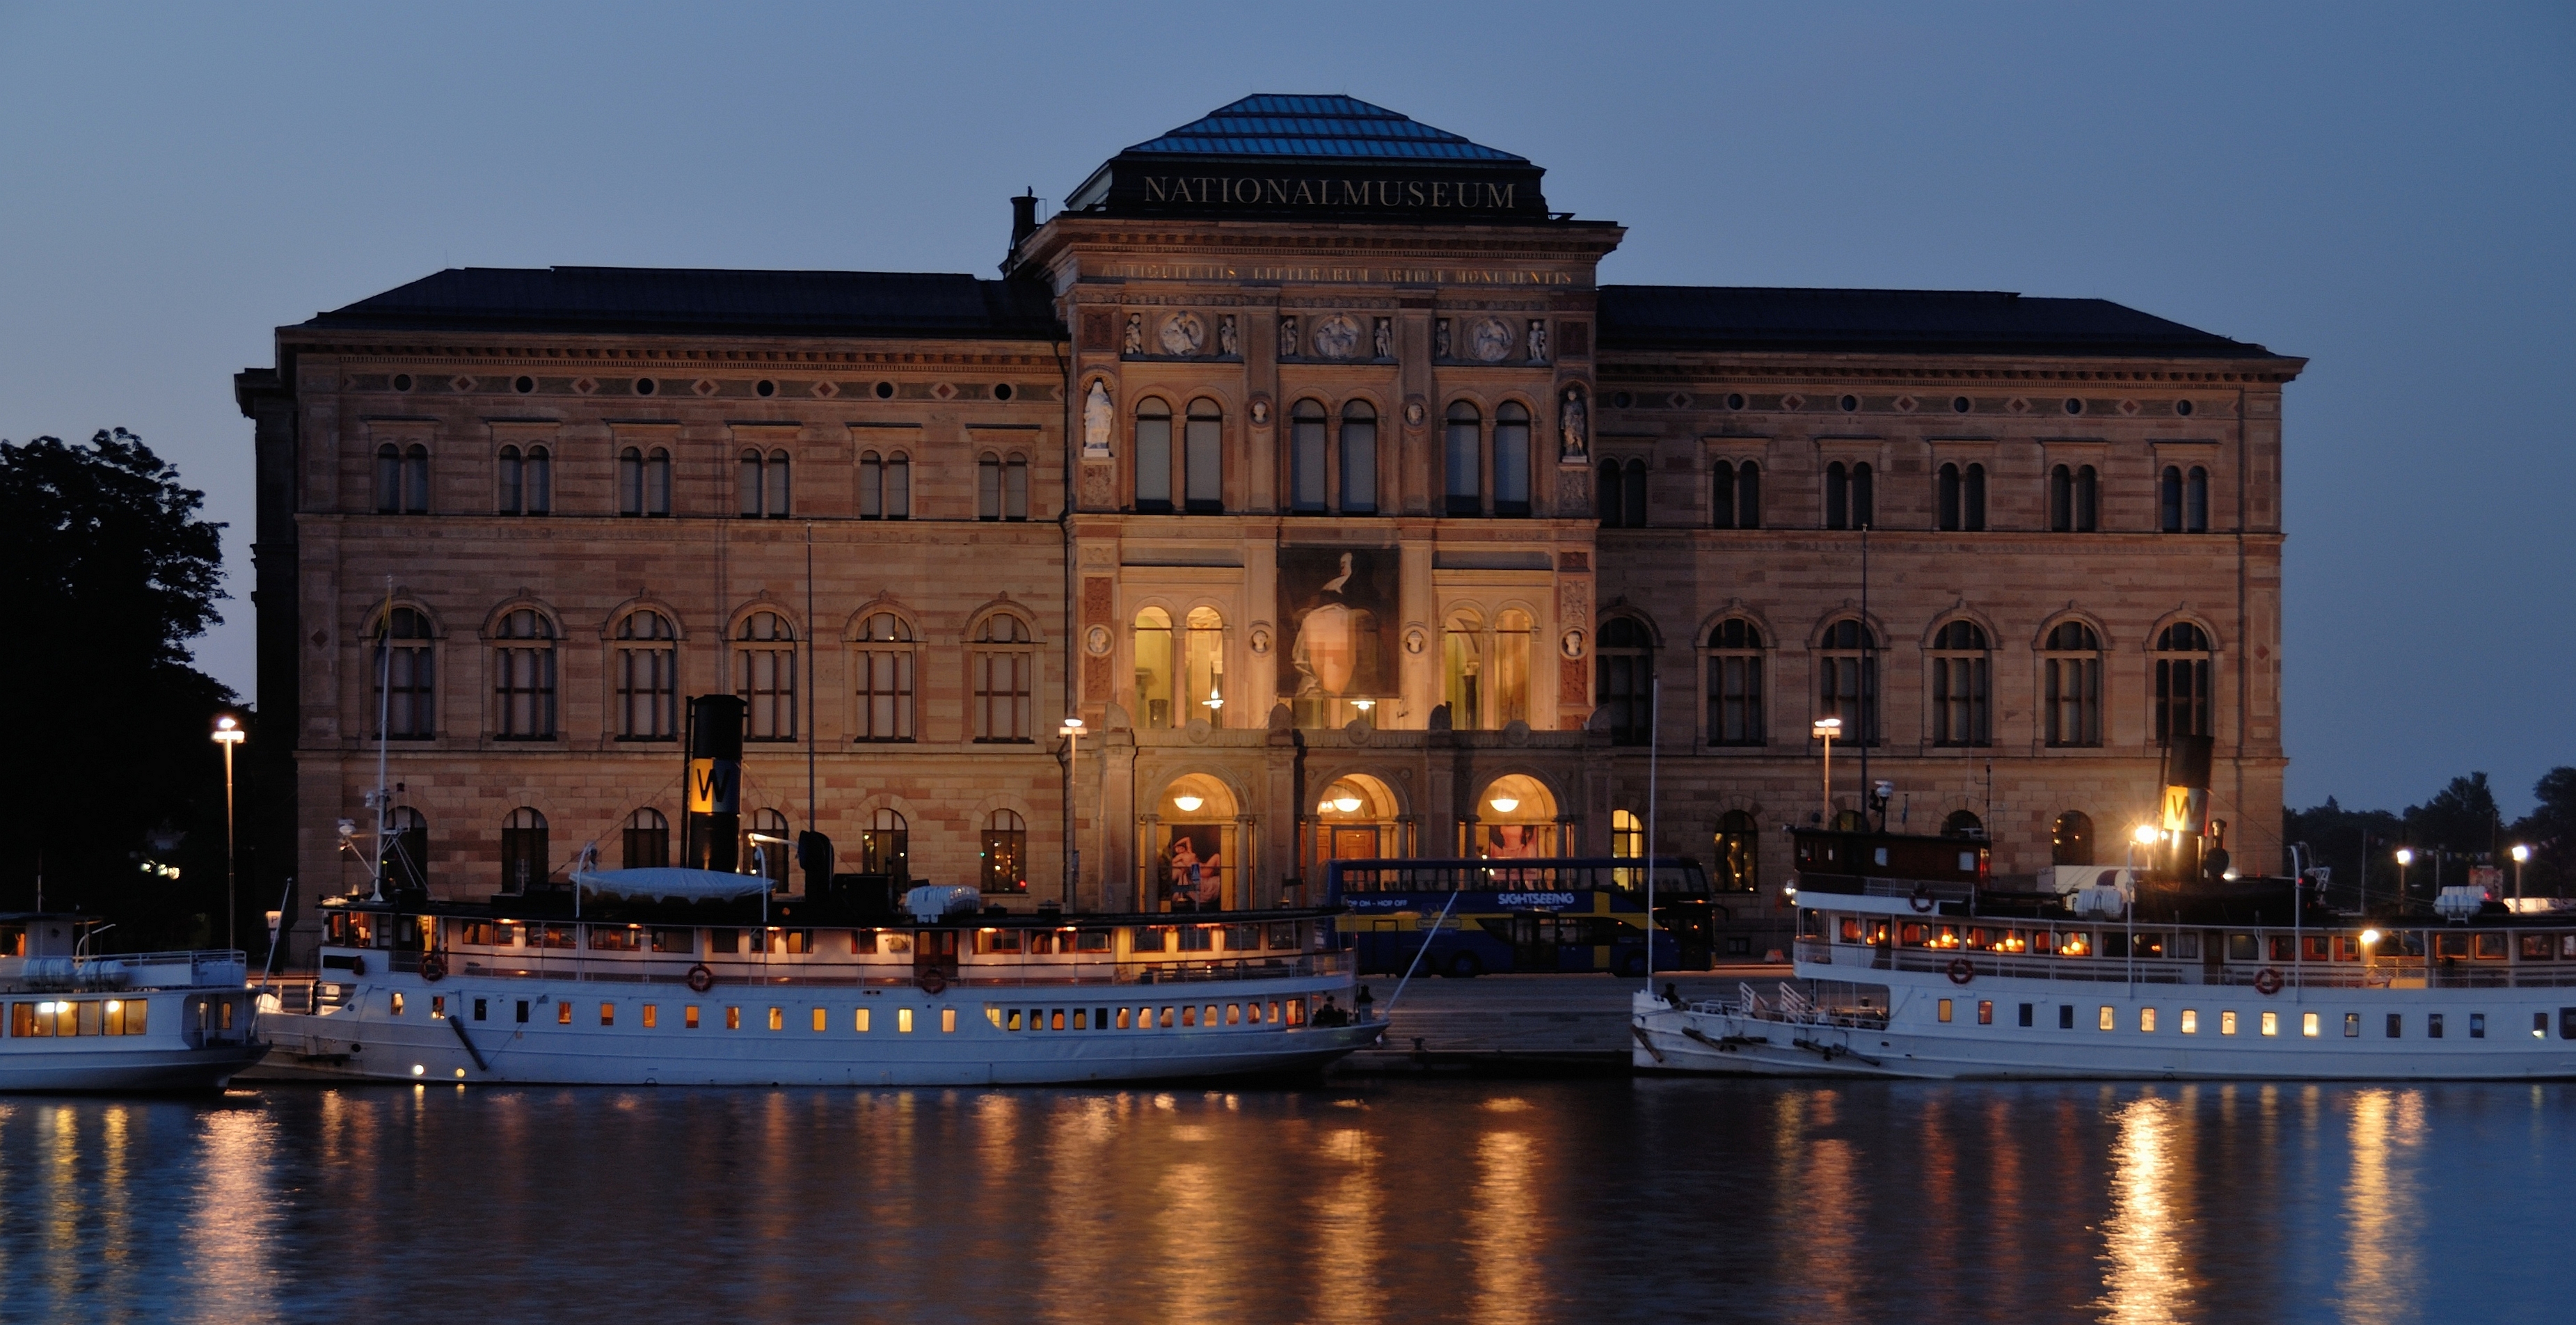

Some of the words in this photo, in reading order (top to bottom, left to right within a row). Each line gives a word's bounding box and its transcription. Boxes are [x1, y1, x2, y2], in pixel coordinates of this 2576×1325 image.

[1144, 175, 1516, 208] NATIONALMUSEUM
[697, 768, 731, 802] W
[2172, 795, 2202, 825] W
[1497, 892, 1575, 905] SIGHTSEEING
